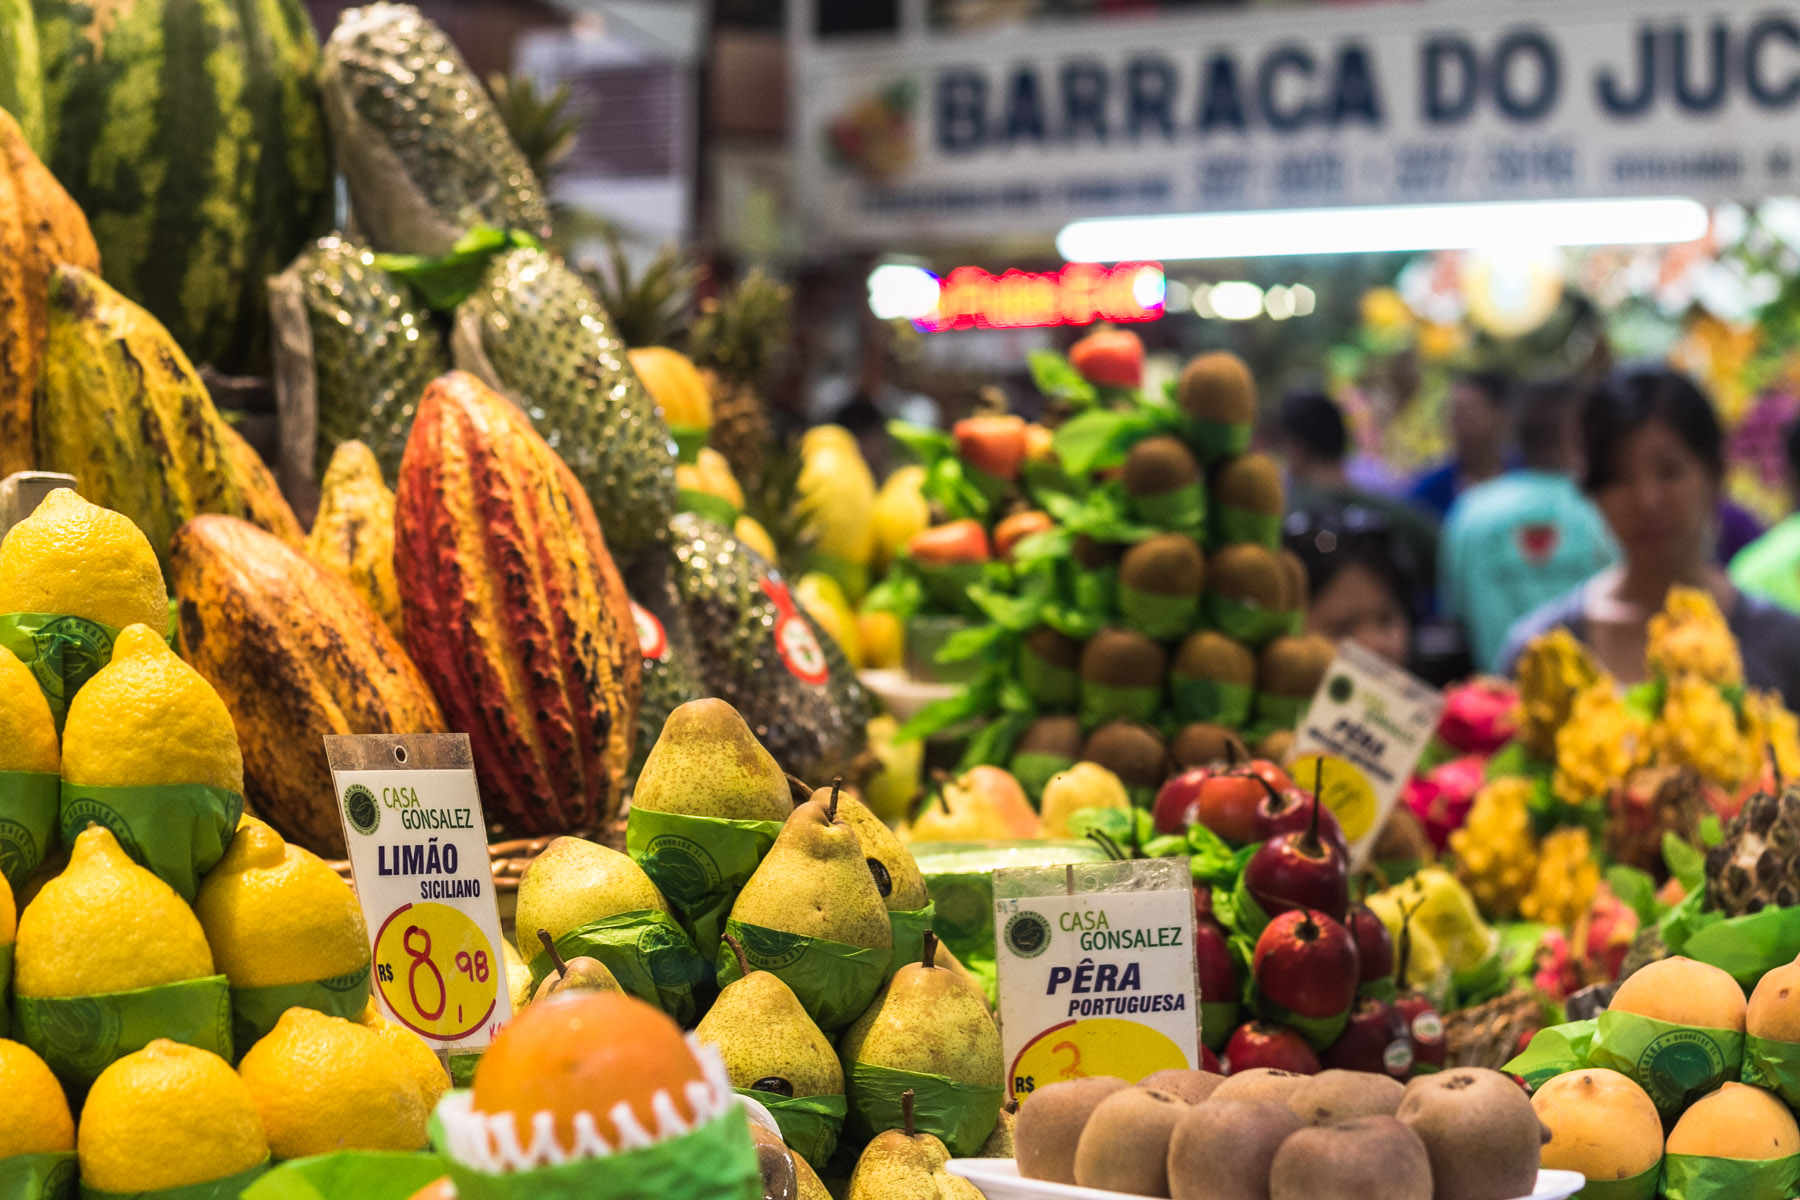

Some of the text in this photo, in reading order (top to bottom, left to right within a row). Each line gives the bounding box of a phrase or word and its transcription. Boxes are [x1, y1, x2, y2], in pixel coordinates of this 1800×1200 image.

[932, 40, 1386, 154] BARRACA
[1417, 25, 1565, 127] DO
[383, 787, 420, 809] CASA
[402, 808, 473, 830] GONSALEZ
[378, 837, 458, 876] LIMÃO
[420, 879, 480, 900] SICILIANO
[1059, 910, 1110, 931] CASA
[1080, 927, 1183, 951] GONSALEZ
[378, 962, 394, 983] R$
[1046, 958, 1141, 995] PÊRA
[1067, 994, 1186, 1017] PORTUGUESA
[1015, 1075, 1035, 1094] R$
